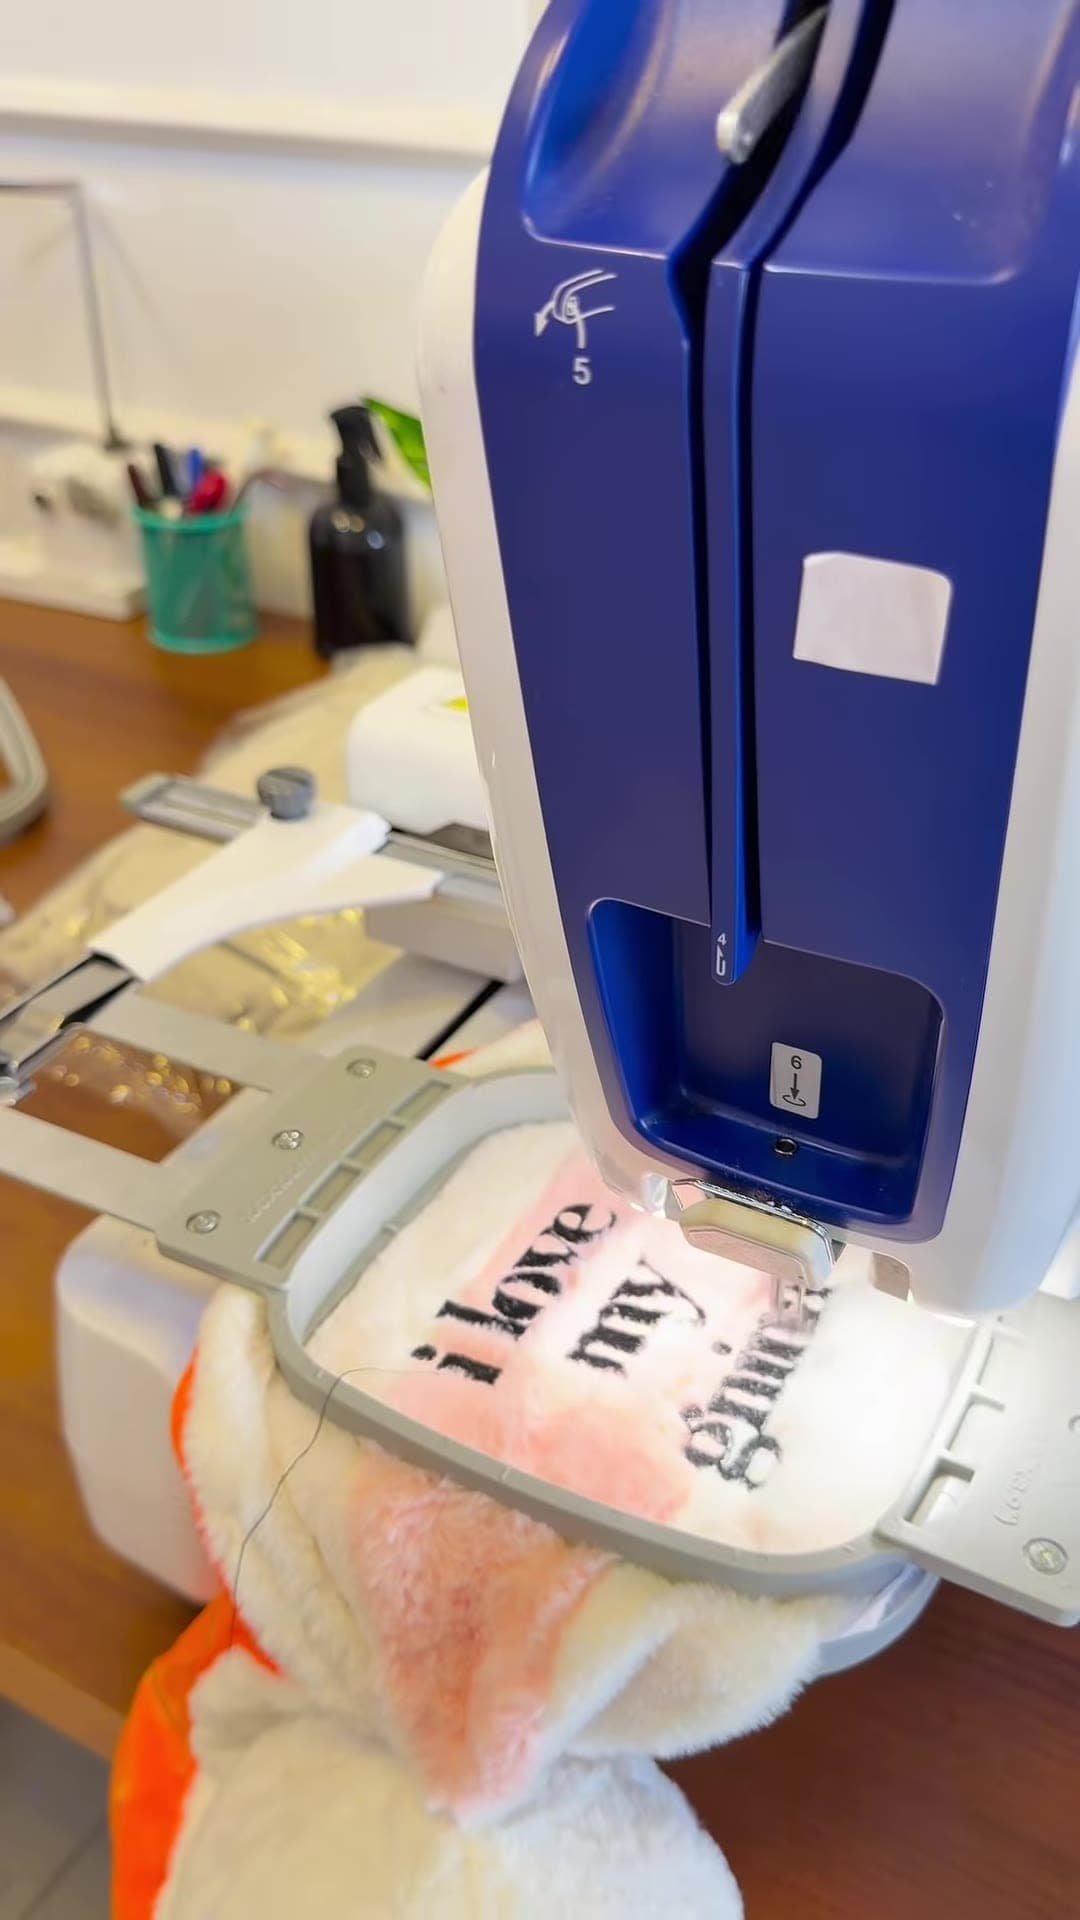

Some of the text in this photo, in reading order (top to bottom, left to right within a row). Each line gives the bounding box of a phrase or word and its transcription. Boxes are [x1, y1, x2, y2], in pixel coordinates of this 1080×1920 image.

[573, 357, 592, 385] 5
[717, 932, 728, 946] 4
[790, 1055, 803, 1070] 6
[410, 1203, 618, 1386] i love
[565, 1254, 706, 1377] my
